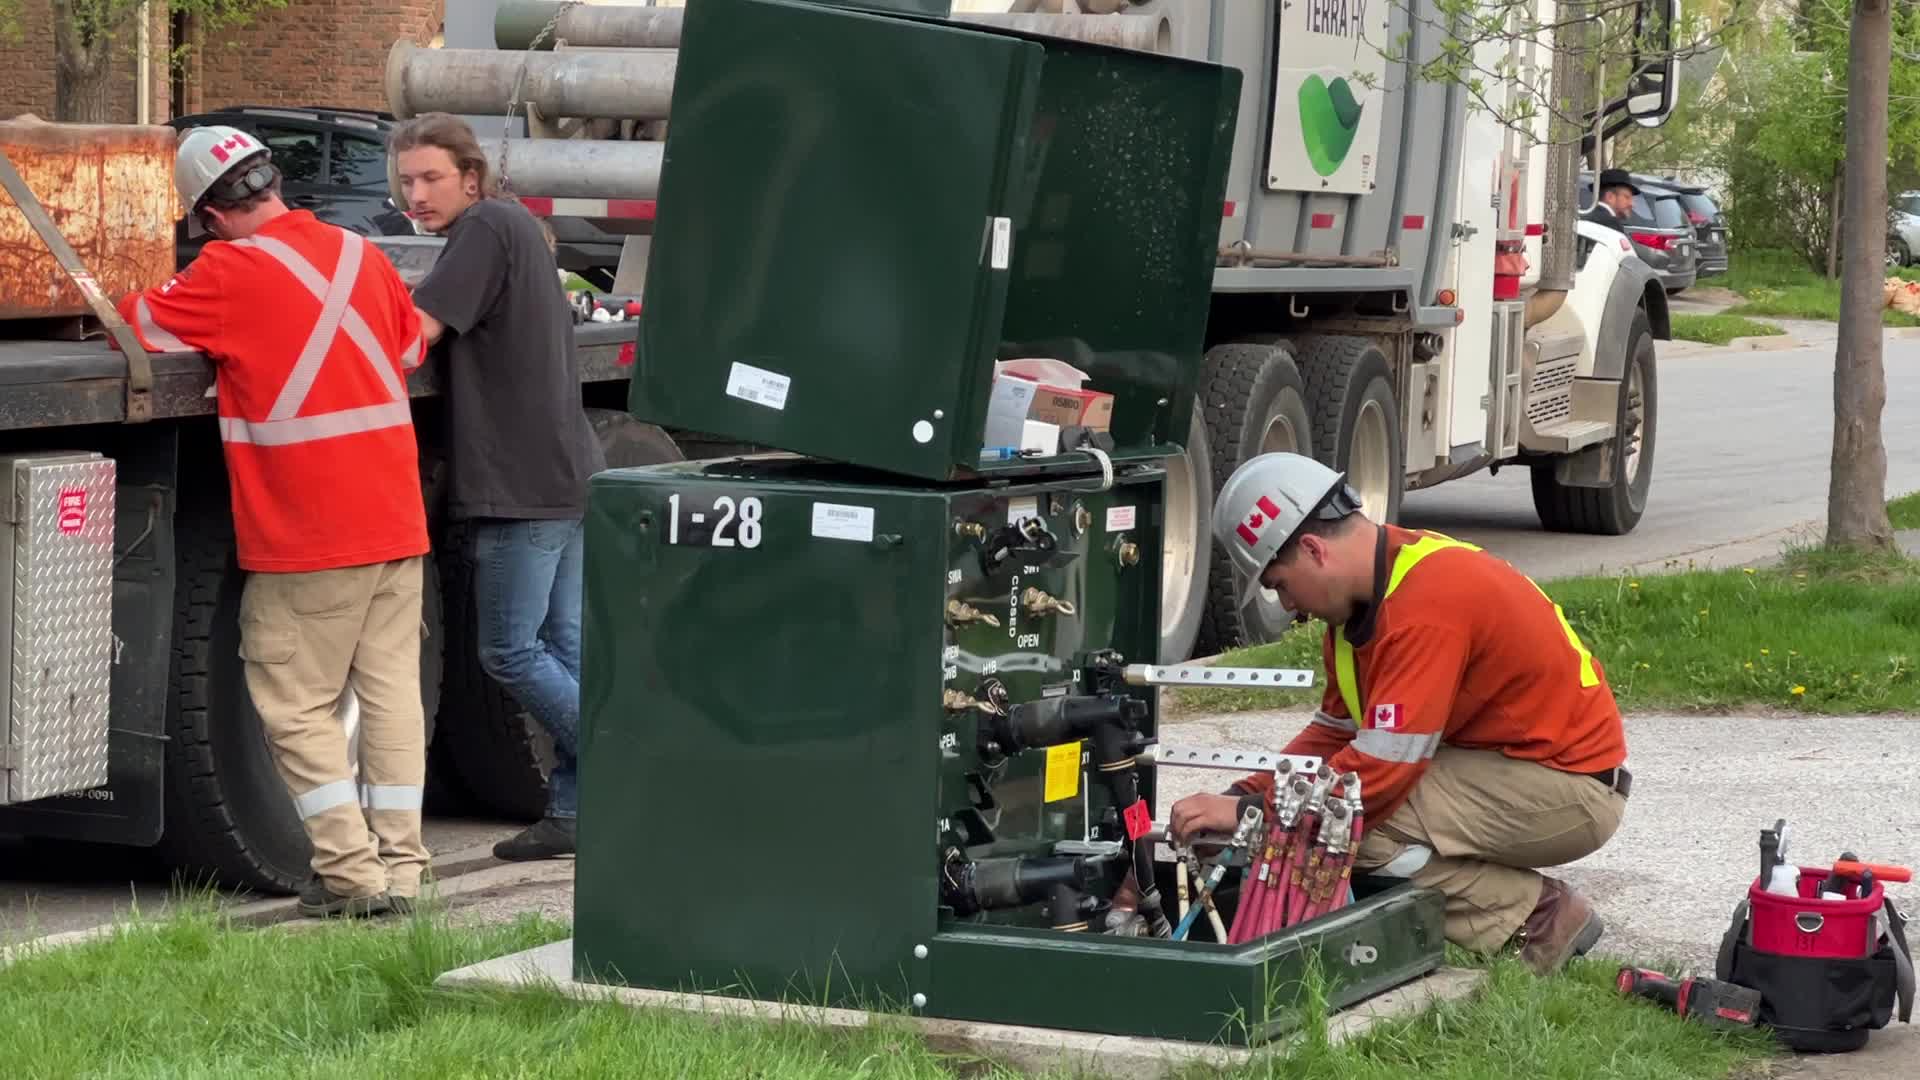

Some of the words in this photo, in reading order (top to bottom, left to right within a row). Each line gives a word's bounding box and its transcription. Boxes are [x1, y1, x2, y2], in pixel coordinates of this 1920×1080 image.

[1306, 0, 1347, 38] TERRA
[669, 494, 763, 549] 1-28
[1008, 575, 1019, 639] CLOSED
[943, 644, 960, 660] PEN
[1017, 634, 1040, 649] OPEN
[939, 731, 956, 749] PEN
